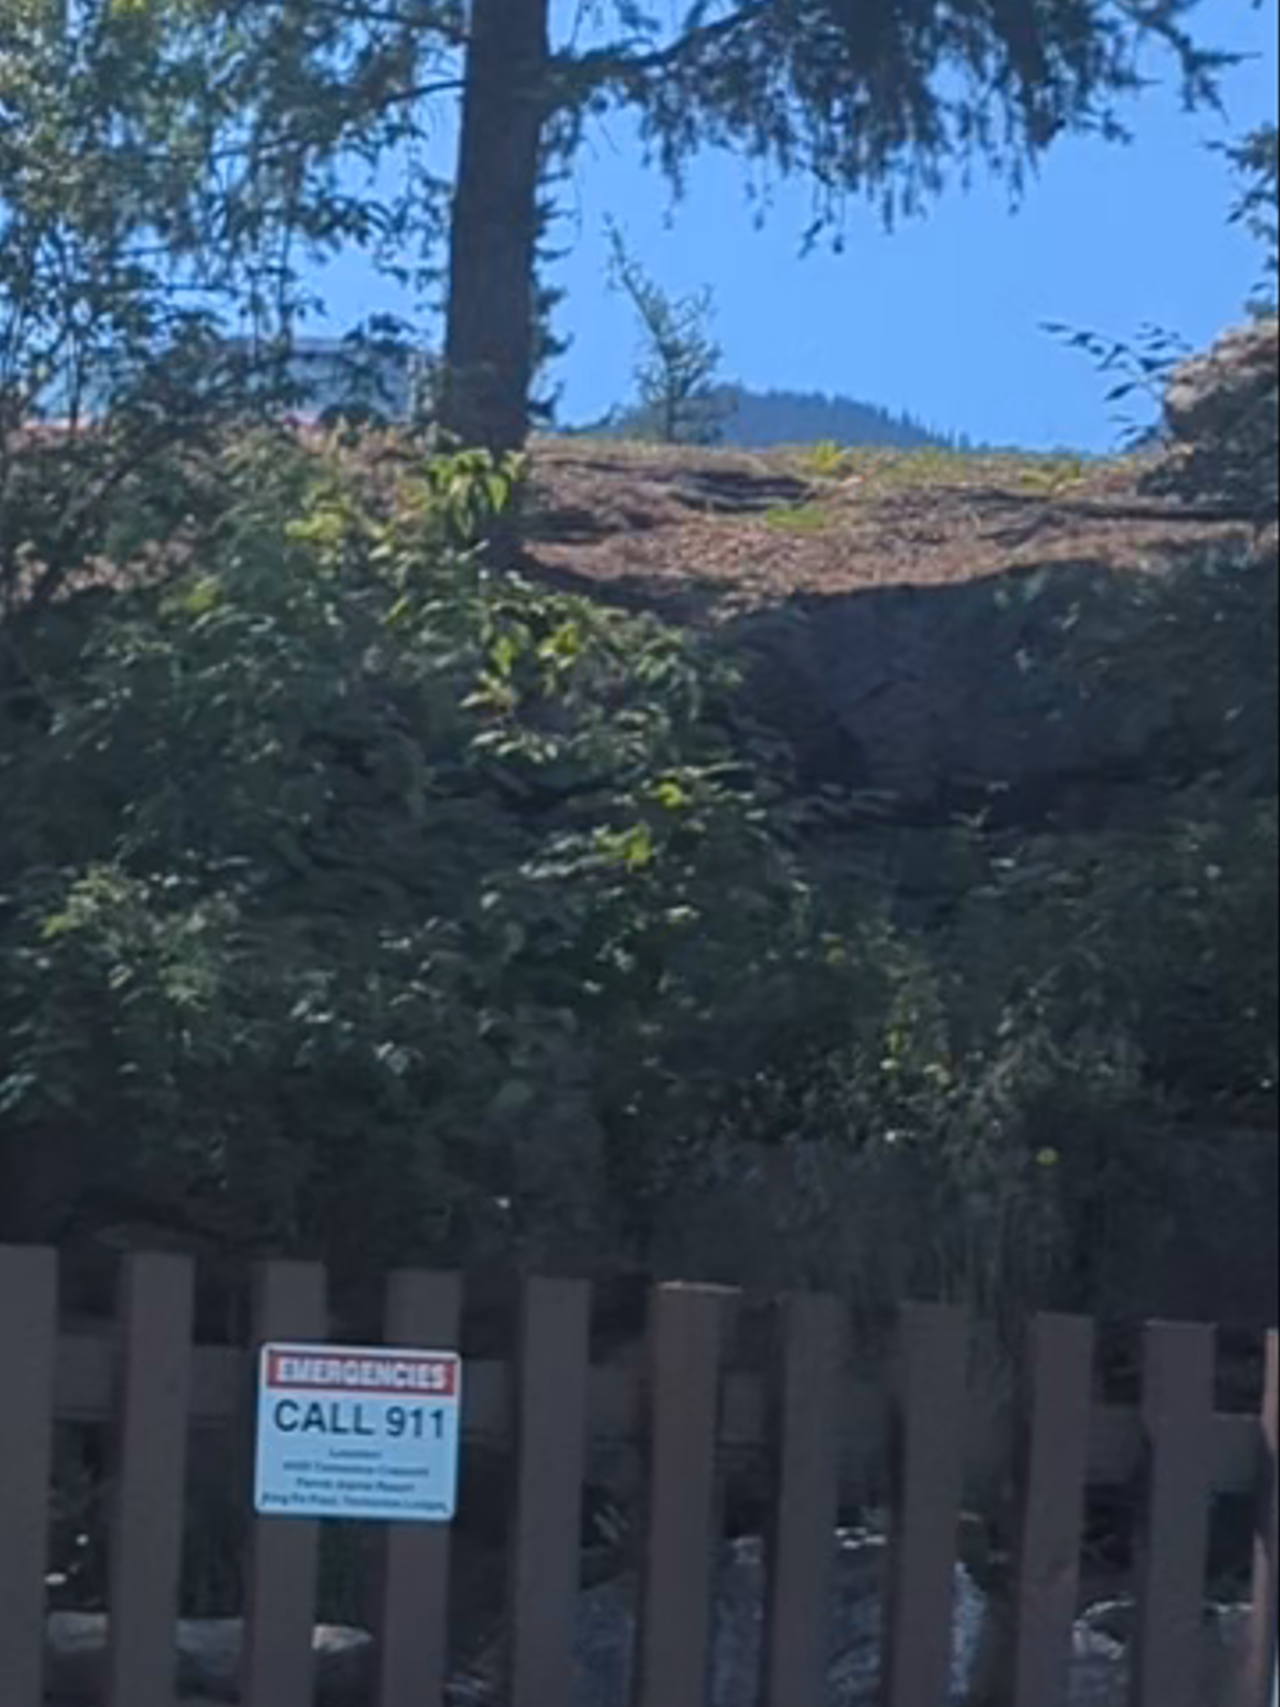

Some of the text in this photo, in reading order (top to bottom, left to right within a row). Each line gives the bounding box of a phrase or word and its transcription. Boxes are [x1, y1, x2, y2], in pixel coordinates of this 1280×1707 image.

[276, 1355, 447, 1391] EMERGENCIES
[274, 1398, 445, 1439] CALL 911
